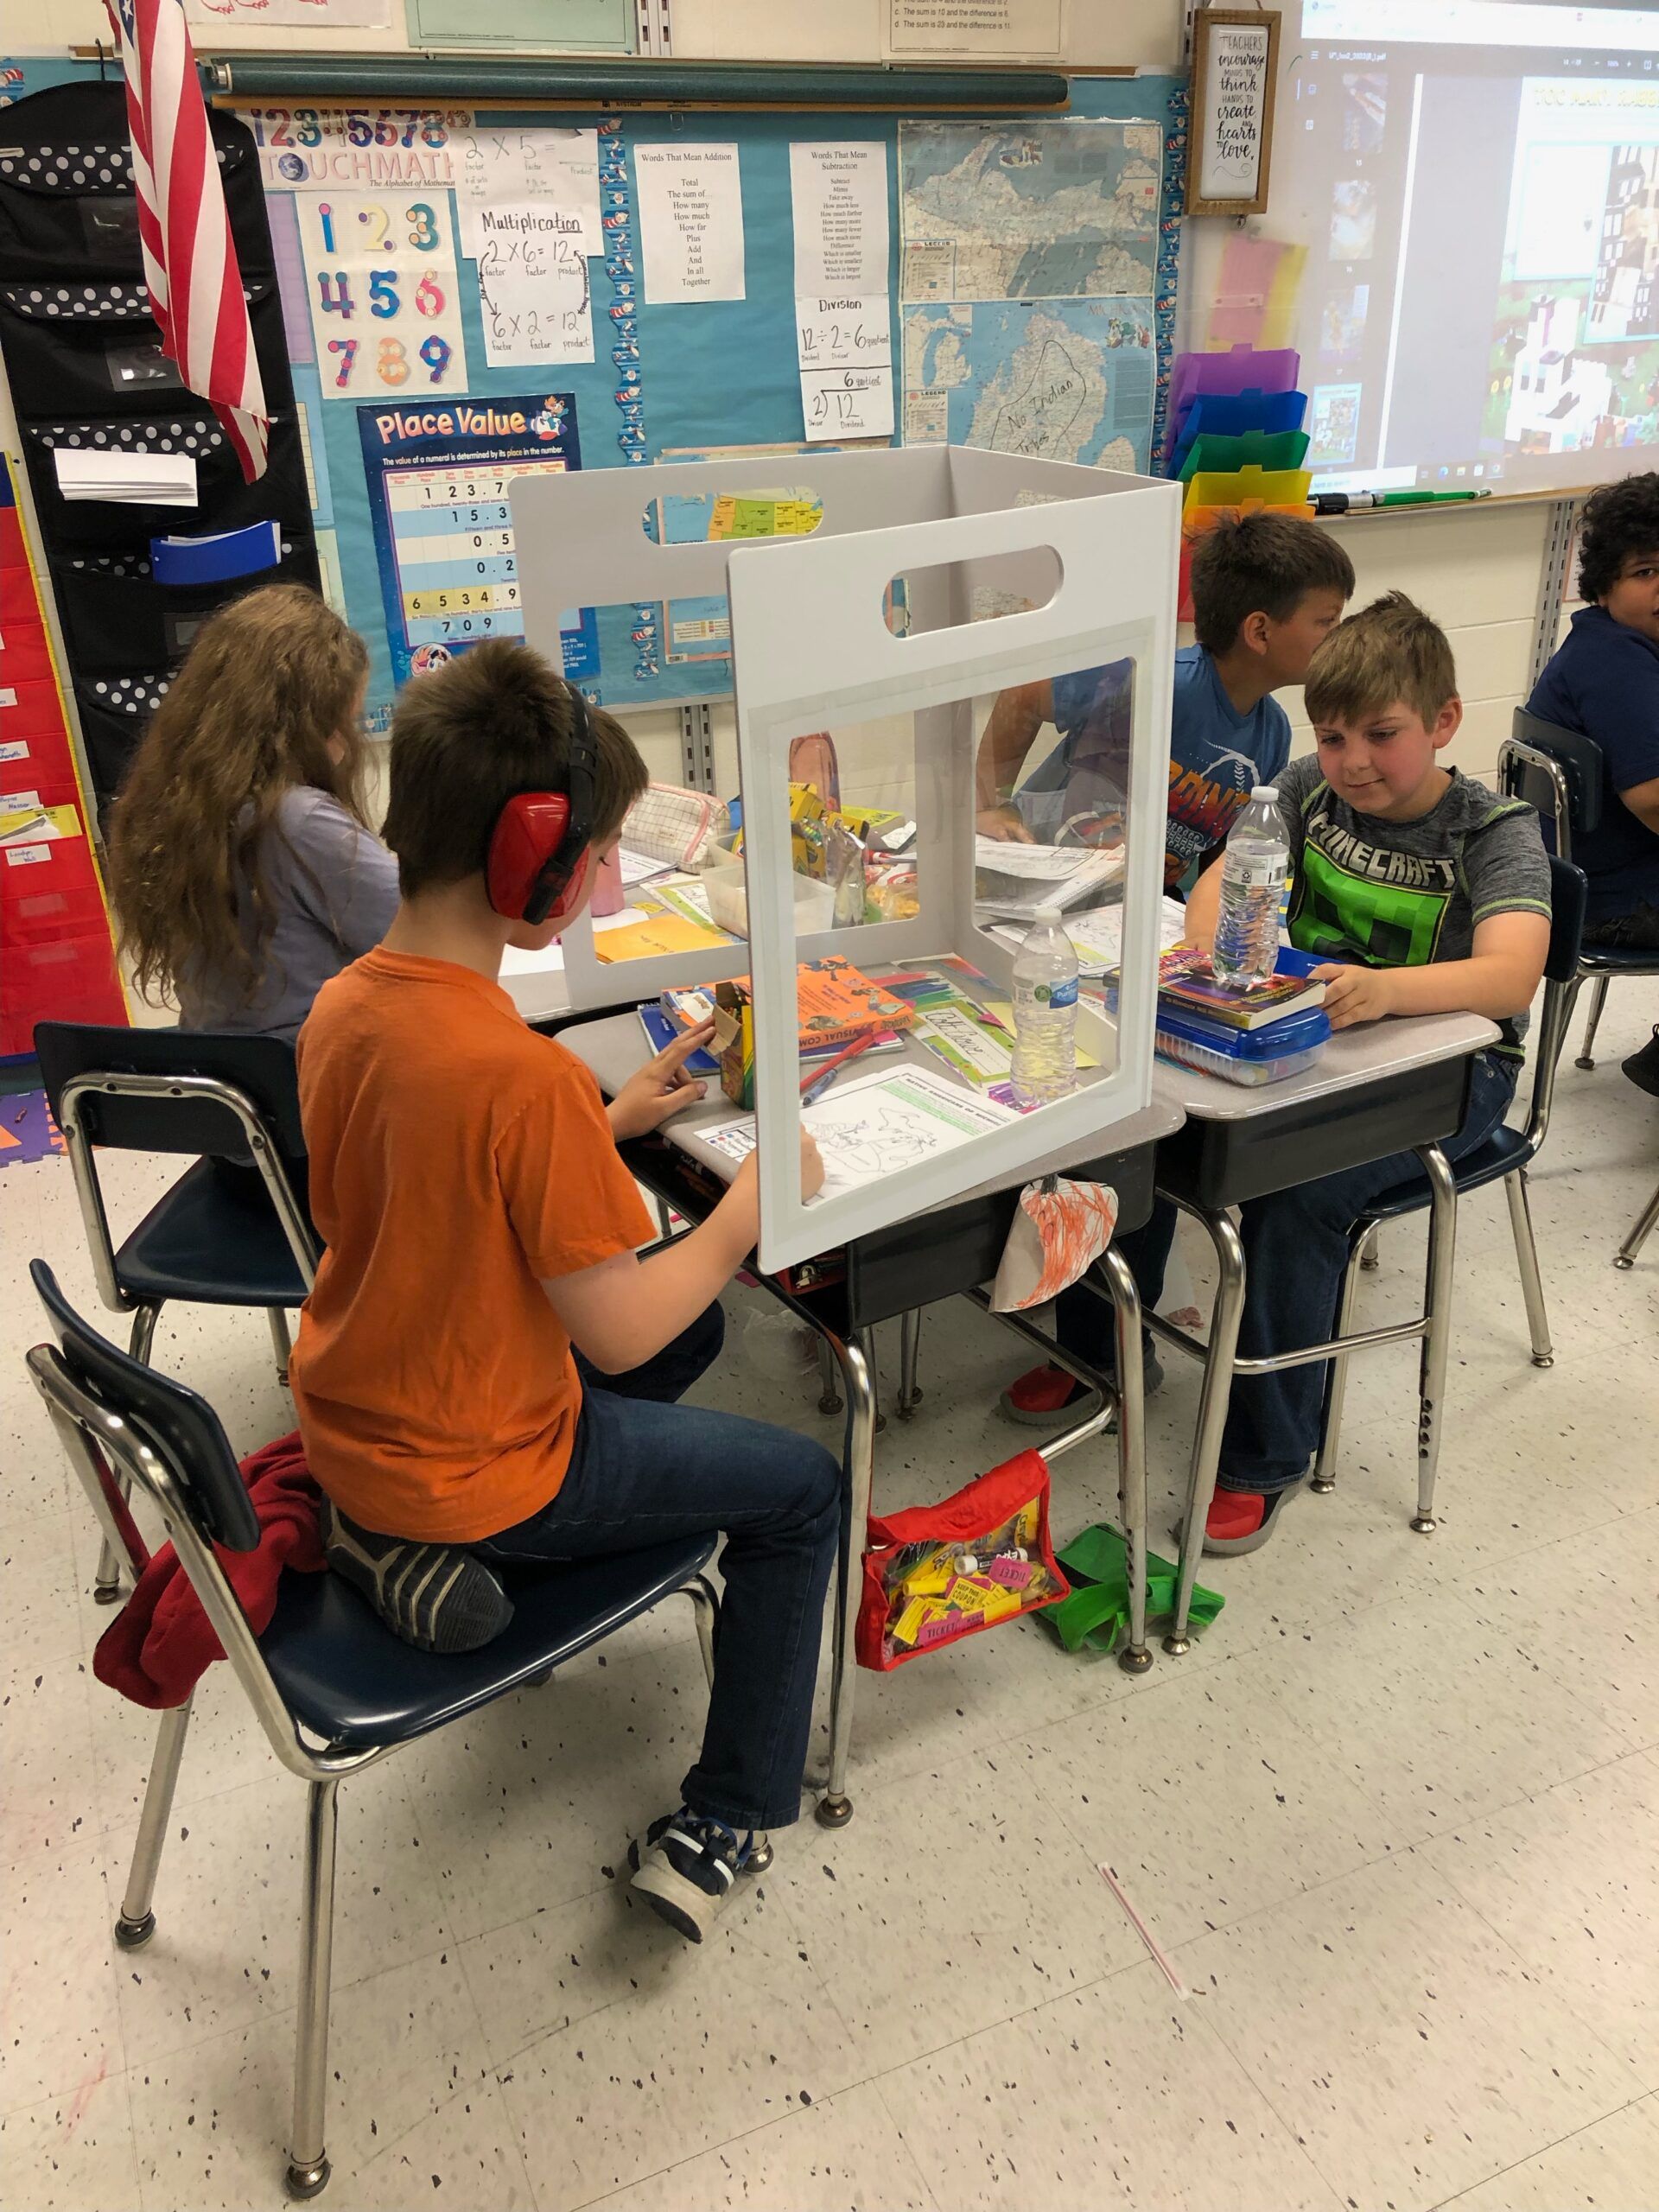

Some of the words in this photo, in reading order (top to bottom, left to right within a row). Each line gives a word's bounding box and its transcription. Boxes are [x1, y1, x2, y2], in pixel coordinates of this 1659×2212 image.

[1219, 36, 1262, 51] TEACHERS
[1217, 54, 1265, 70] encourage
[1222, 94, 1243, 104] HANDS
[1247, 95, 1253, 104] TO
[1217, 121, 1256, 140] hearts
[465, 136, 484, 159] 2
[520, 135, 537, 159] 5
[641, 153, 664, 162] Words
[666, 153, 682, 162] That
[683, 153, 702, 162] Mean
[704, 153, 732, 162] Addition
[319, 203, 334, 252] 1
[359, 205, 394, 251] 2
[406, 203, 439, 251] 3
[482, 212, 581, 234] Multiplication
[487, 240, 507, 262] 2
[523, 240, 536, 262] 6
[554, 240, 573, 263] 12
[486, 265, 505, 276] factor
[525, 265, 546, 276] factor
[558, 266, 582, 280] product
[682, 278, 710, 287] Together
[318, 271, 354, 318] 4
[369, 270, 400, 319] 5
[415, 270, 446, 320] 6
[493, 313, 505, 338] 6
[527, 311, 541, 334] 2
[563, 311, 579, 332] 12
[492, 340, 512, 351] factor
[530, 340, 551, 349] factor
[563, 337, 589, 351] product
[802, 327, 817, 351] 12
[831, 325, 842, 348] 2
[854, 324, 866, 349] 6
[327, 340, 357, 387] 7
[378, 337, 407, 385] 8
[419, 334, 450, 383] 9
[844, 372, 854, 387] 6
[837, 393, 859, 418] 12
[1007, 415, 1027, 432] No
[1029, 378, 1073, 415] Indian
[376, 411, 453, 444] Place
[454, 406, 528, 436] Value
[1015, 434, 1050, 453] Tribes
[383, 457, 394, 466] The
[425, 453, 449, 463] numeral
[450, 452, 455, 461] is
[456, 451, 490, 461] determined
[491, 450, 498, 460] by
[506, 449, 523, 459] place
[1307, 810, 1456, 889] MINECRAFT
[999, 1567, 1027, 1582] TICKET
[952, 1590, 976, 1605] COUPON
[957, 1582, 969, 1592] KEEP
[969, 1587, 979, 1598] THIS
[927, 1622, 956, 1638] TICKET
